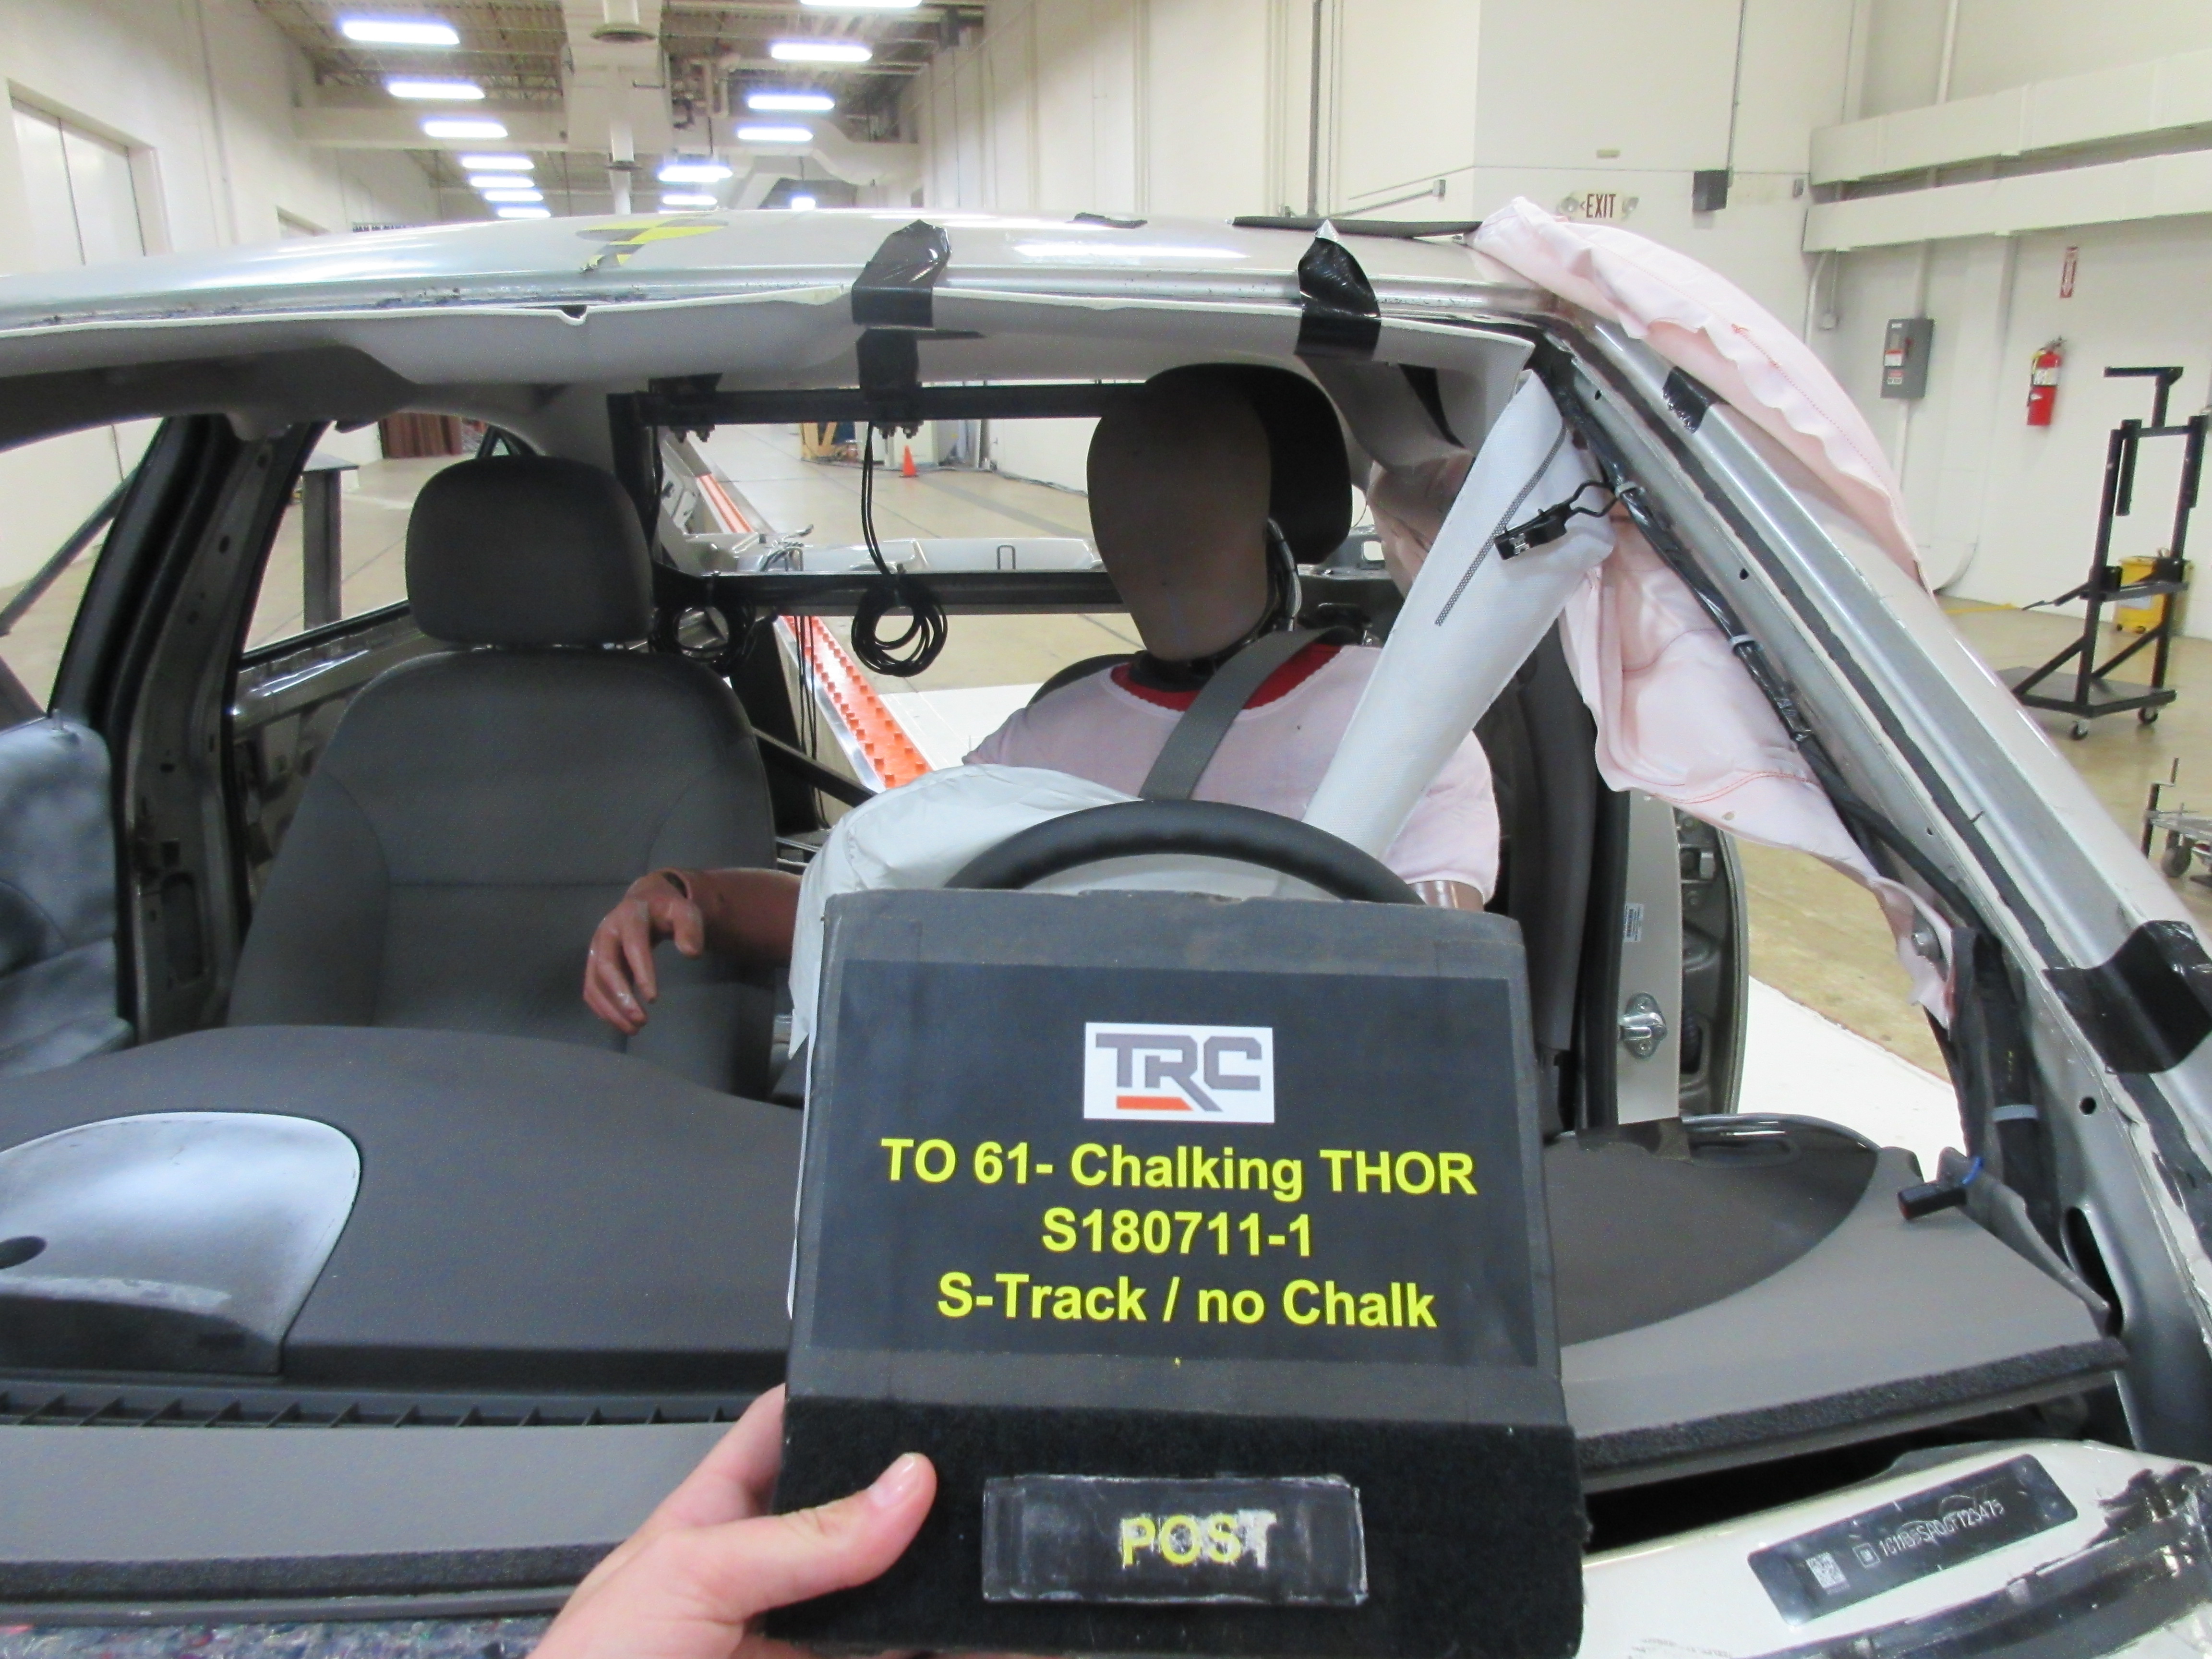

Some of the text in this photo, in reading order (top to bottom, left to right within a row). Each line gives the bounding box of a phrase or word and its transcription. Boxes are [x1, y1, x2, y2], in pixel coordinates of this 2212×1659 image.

[1586, 193, 1616, 218] EXIT
[1095, 1032, 1262, 1112] TRC
[879, 1137, 1478, 1203] TO 61- Chalking THOR
[1041, 1206, 1311, 1257] S180711-1
[937, 1270, 1438, 1328] S-Track / no Chalk
[1119, 1509, 1277, 1569] POST
